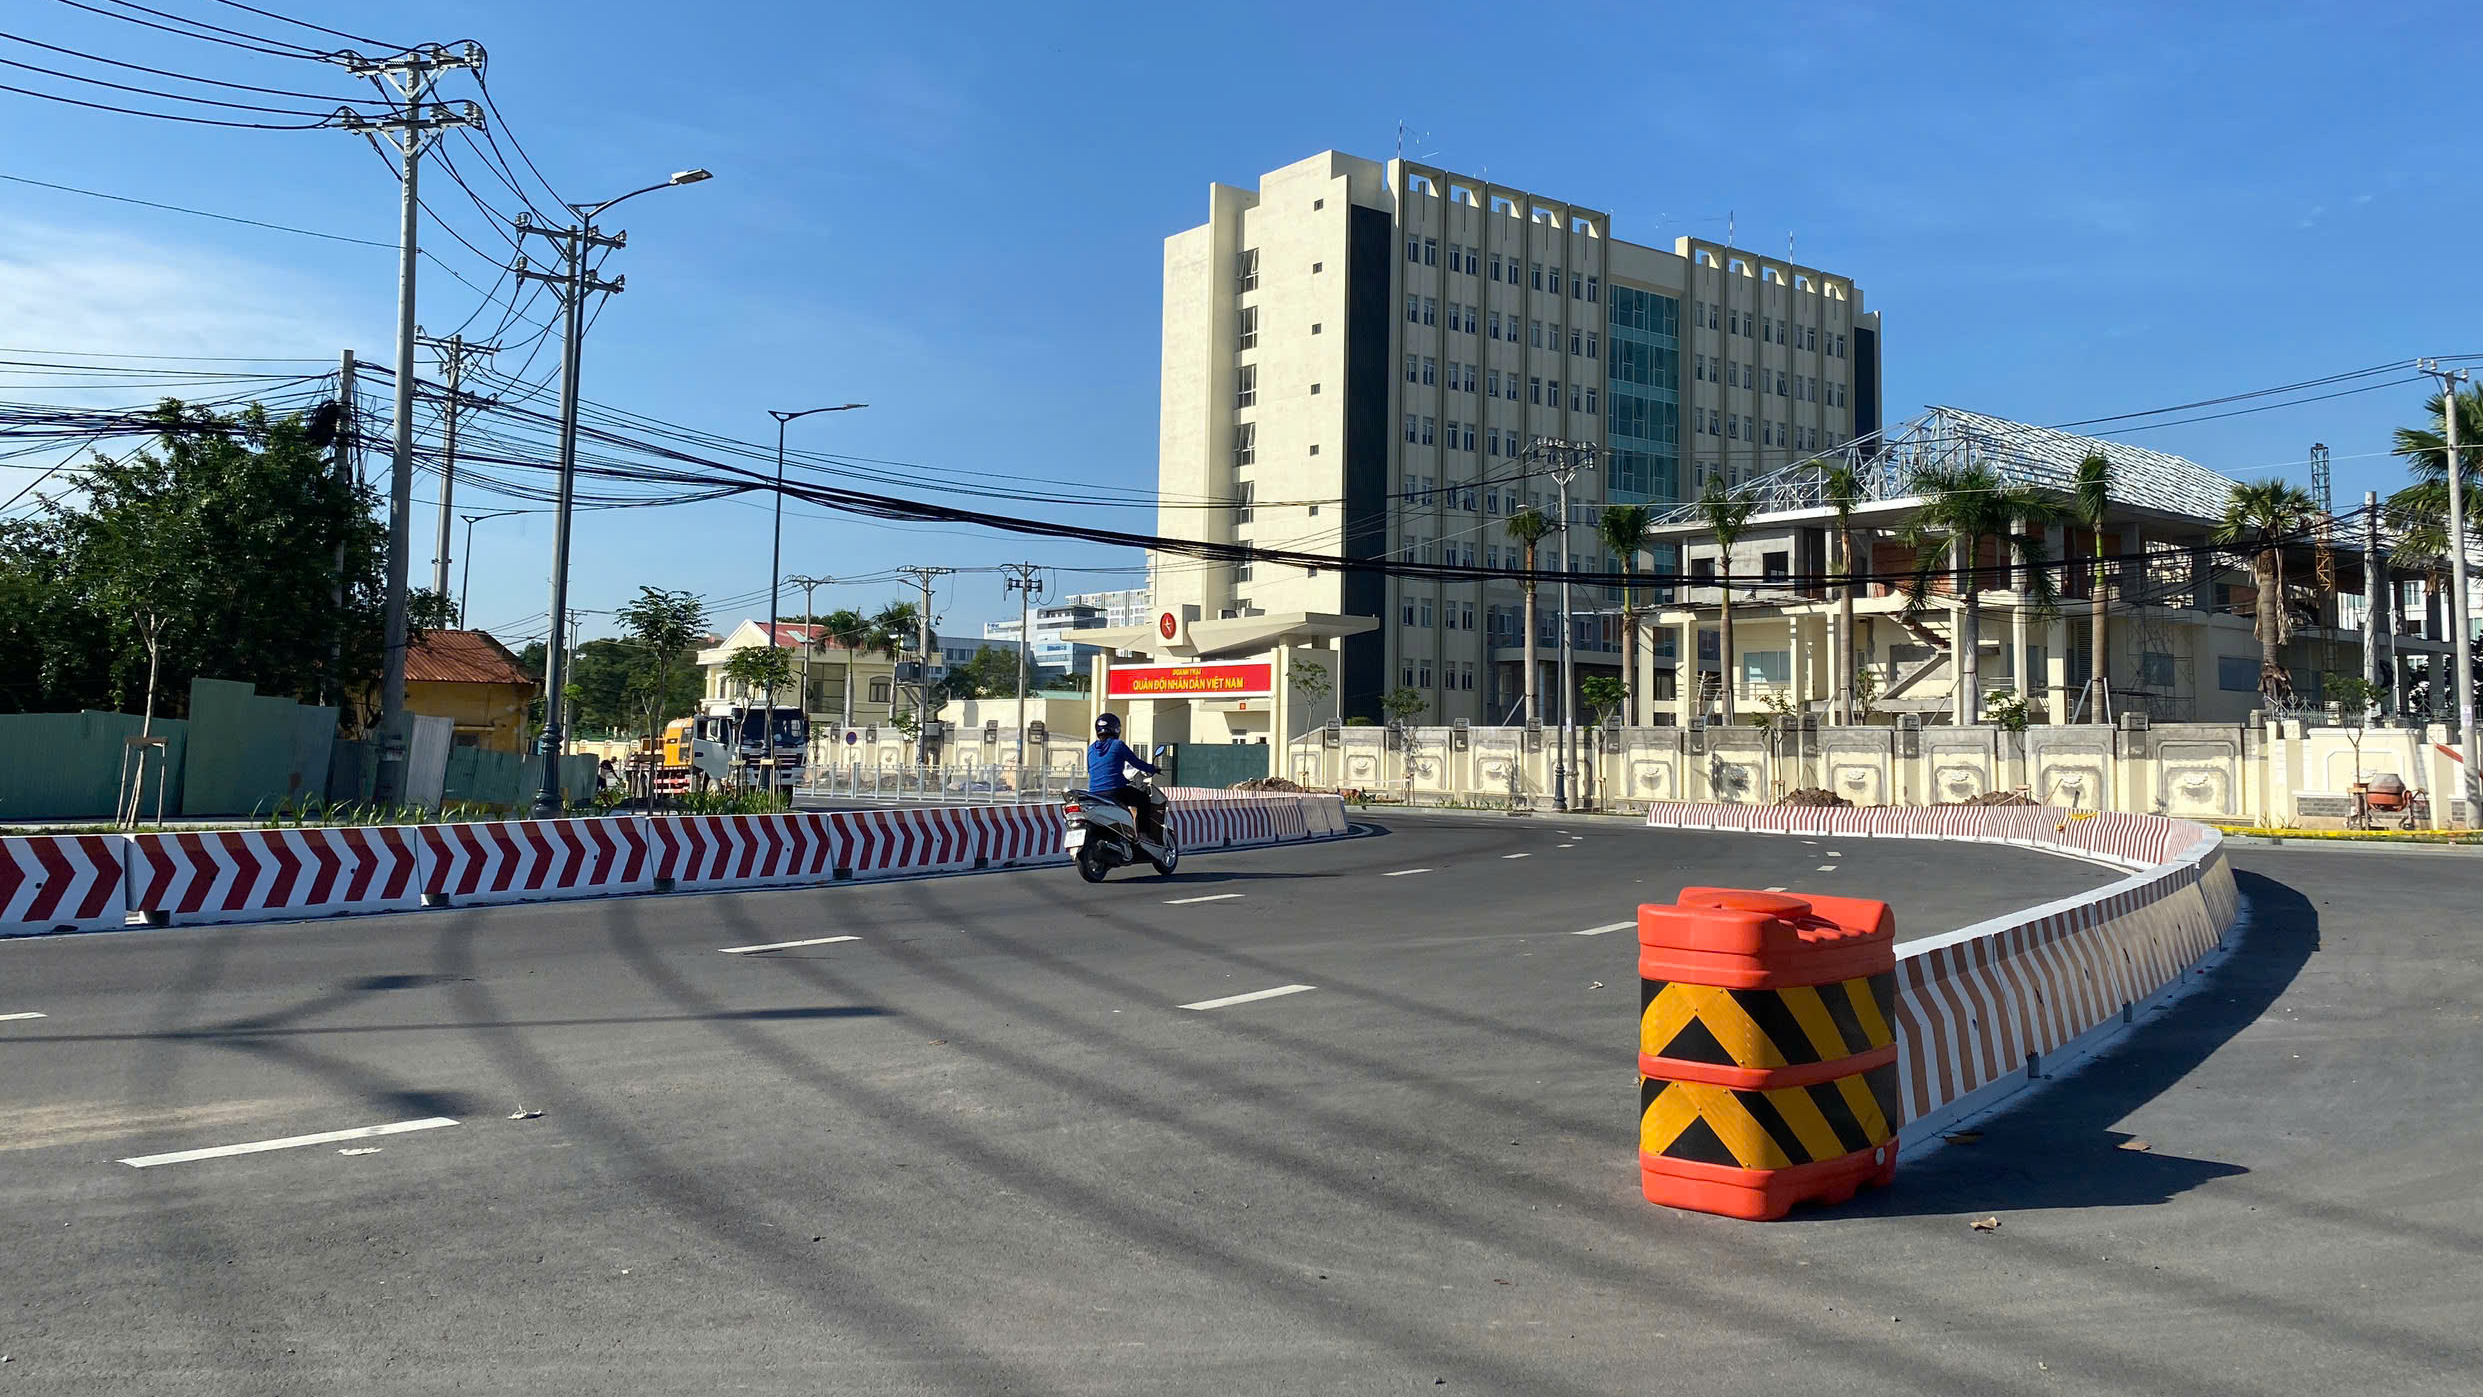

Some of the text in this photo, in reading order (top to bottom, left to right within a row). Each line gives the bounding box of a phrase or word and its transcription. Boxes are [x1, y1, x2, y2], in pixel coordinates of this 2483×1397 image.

[1133, 676, 1244, 692] QUÂN ĐỘI NHÂN DÂN VIỆT NAM
